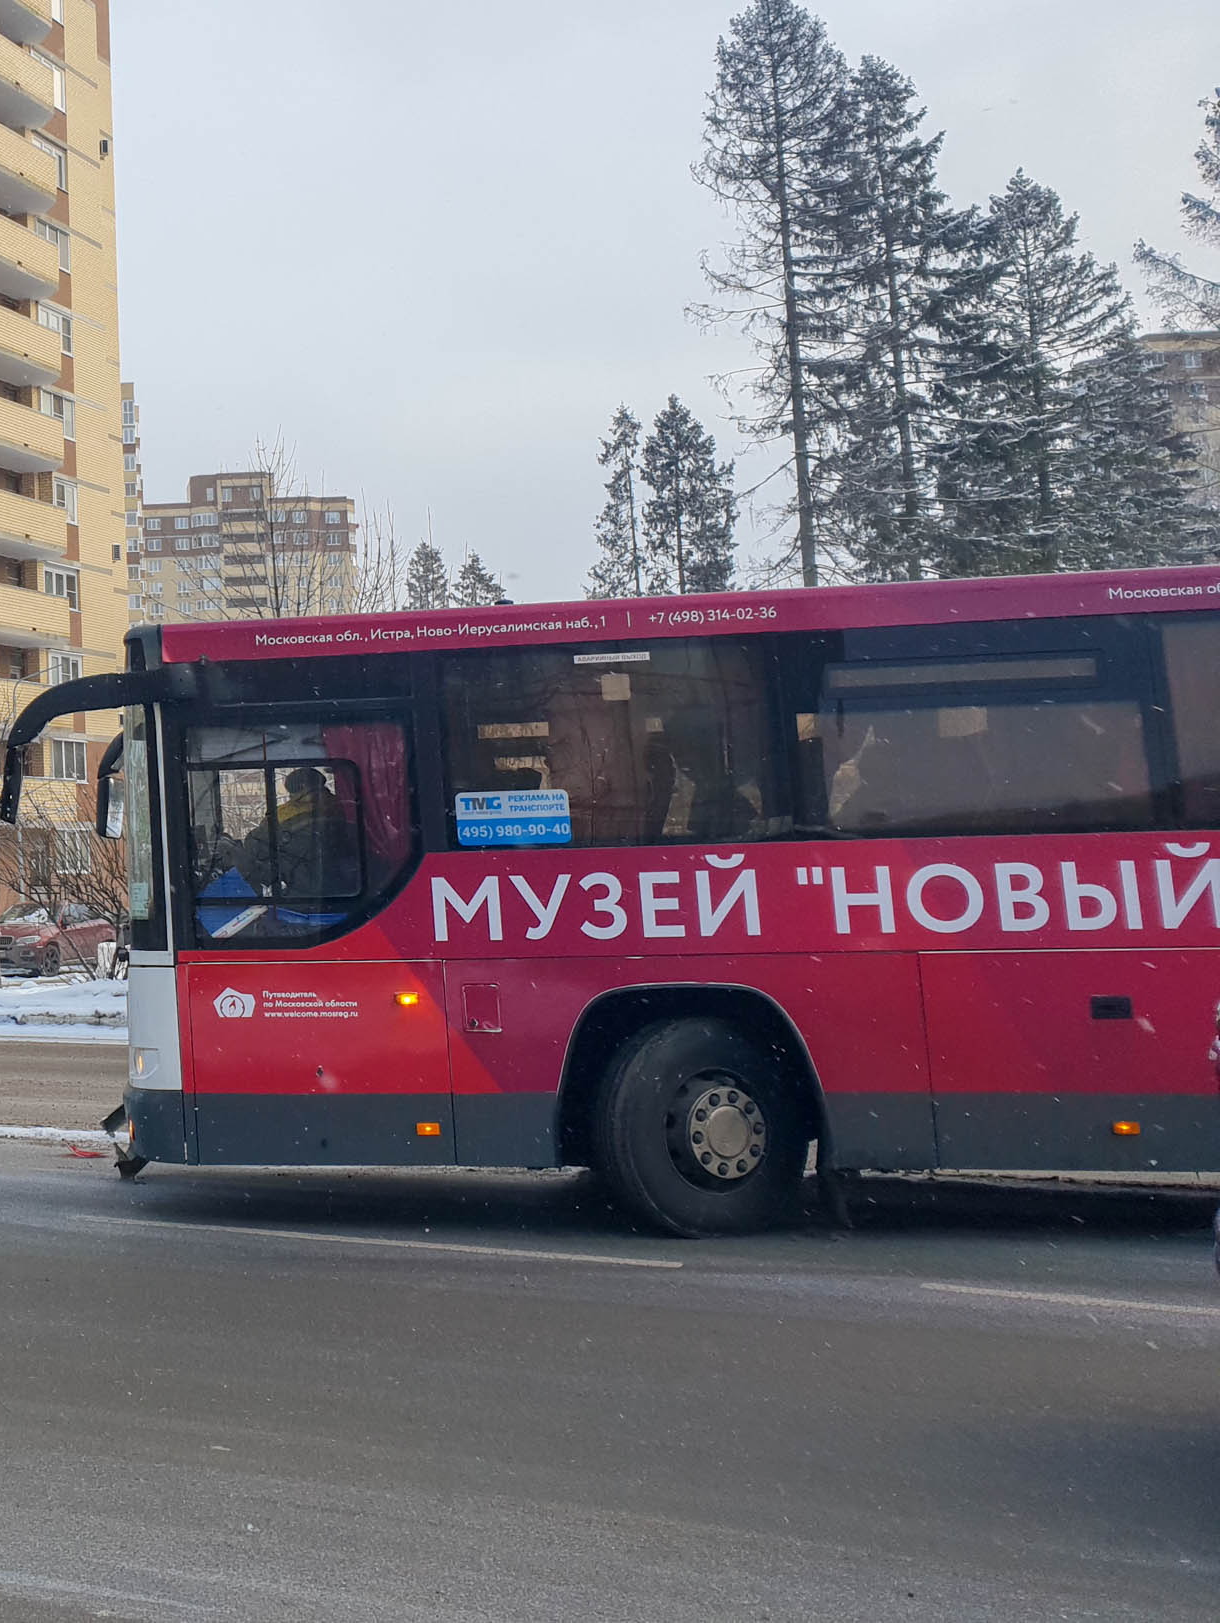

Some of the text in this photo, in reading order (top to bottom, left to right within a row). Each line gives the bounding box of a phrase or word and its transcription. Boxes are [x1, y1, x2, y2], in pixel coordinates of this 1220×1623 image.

[1109, 585, 1203, 600] Московская
[648, 606, 777, 626] +7 (498) 314-02-36
[255, 633, 332, 646] Московская
[370, 628, 414, 641] Истра,
[417, 620, 562, 637] Ново-Иерусалимская
[601, 615, 606, 628] 1
[508, 793, 565, 803] РЕКЛАМА НА
[509, 803, 565, 812] ТРАНСПОРТЕ
[457, 822, 570, 840] (495) 980-90-40
[430, 842, 1220, 942] МУЗЕЙ "НОВЫЙ
[262, 990, 317, 999] Путеводитель
[275, 999, 324, 1008] Московской
[325, 999, 358, 1007] области
